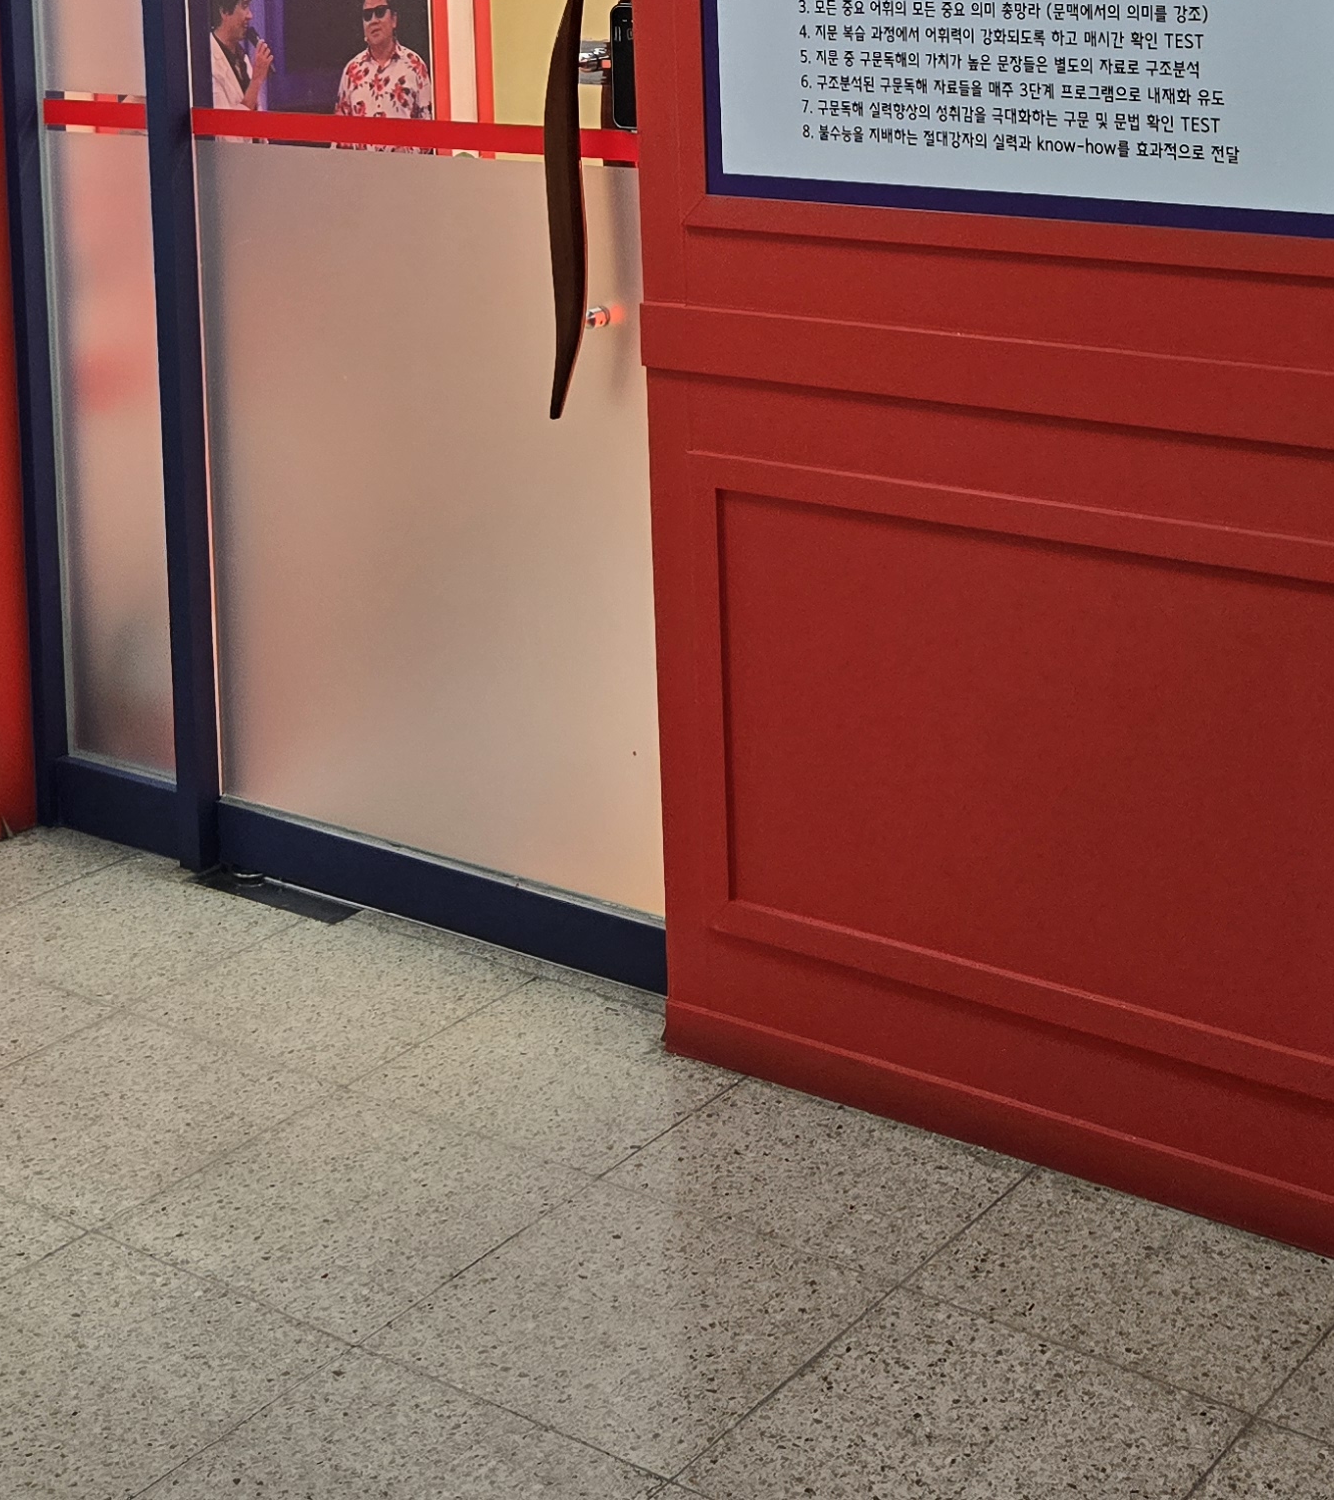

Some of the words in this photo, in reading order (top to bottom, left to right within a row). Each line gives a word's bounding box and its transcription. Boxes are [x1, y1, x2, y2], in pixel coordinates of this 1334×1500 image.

[799, 0, 810, 14] 3.
[815, 0, 837, 15] 모든
[842, 0, 865, 16] 중요
[870, 0, 906, 16] 어휘의
[913, 2, 935, 17] 모든
[941, 2, 965, 18] 중요
[971, 2, 996, 18] 의미
[1001, 1, 1041, 20] 총망라
[1046, 3, 1120, 21] (문맥에서의
[1127, 5, 1167, 22] 의미를
[1173, 5, 1209, 23] 강조)
[799, 25, 810, 39] 4.
[816, 25, 837, 41] 지문
[843, 25, 865, 41] 복습
[871, 26, 919, 43] 과정에서
[925, 28, 974, 44] 어휘력이
[981, 28, 1046, 46] 강화되도록
[1052, 31, 1077, 46] 하고
[1085, 31, 1124, 49] 매시간
[1131, 32, 1158, 50] 확인
[1164, 33, 1204, 49] TEST
[801, 50, 811, 63] 5.
[816, 50, 838, 66] 지문
[844, 50, 855, 67] 중
[861, 52, 920, 68] 구문독해의
[926, 53, 962, 70] 가치가
[968, 54, 992, 72] 높은
[997, 55, 1048, 74] 문장들은
[1054, 57, 1093, 74] 별도의
[1100, 59, 1140, 75] 자료로
[1146, 60, 1200, 78] 구조분석
[801, 75, 812, 89] 6.
[817, 75, 875, 93] 구조분석된
[881, 77, 927, 94] 구문독해
[934, 79, 982, 96] 자료들을
[988, 81, 1014, 98] 매주
[1020, 83, 1055, 100] 3단계
[1061, 85, 1141, 102] 프로그램으로
[1148, 87, 1191, 105] 내재화
[1198, 89, 1225, 106] 유도
[802, 100, 812, 113] 7.
[818, 100, 864, 117] 구문독해
[869, 102, 930, 120] 실력향상의
[936, 105, 986, 124] 성취감을
[992, 107, 1058, 127] 극대화하는
[1064, 112, 1089, 129] 구문
[1096, 112, 1107, 130] 및
[1114, 113, 1140, 131] 문법
[1147, 114, 1174, 133] 확인
[1181, 116, 1220, 133] TEST
[803, 125, 813, 139] 8.
[818, 125, 864, 142] 불수능을
[870, 128, 918, 145] 지배하는
[924, 130, 987, 149] 절대강자의
[993, 133, 1032, 151] 실력과
[1037, 136, 1130, 158] know-how를
[1136, 141, 1205, 161] 효과적으로
[1211, 145, 1240, 164] 전달
